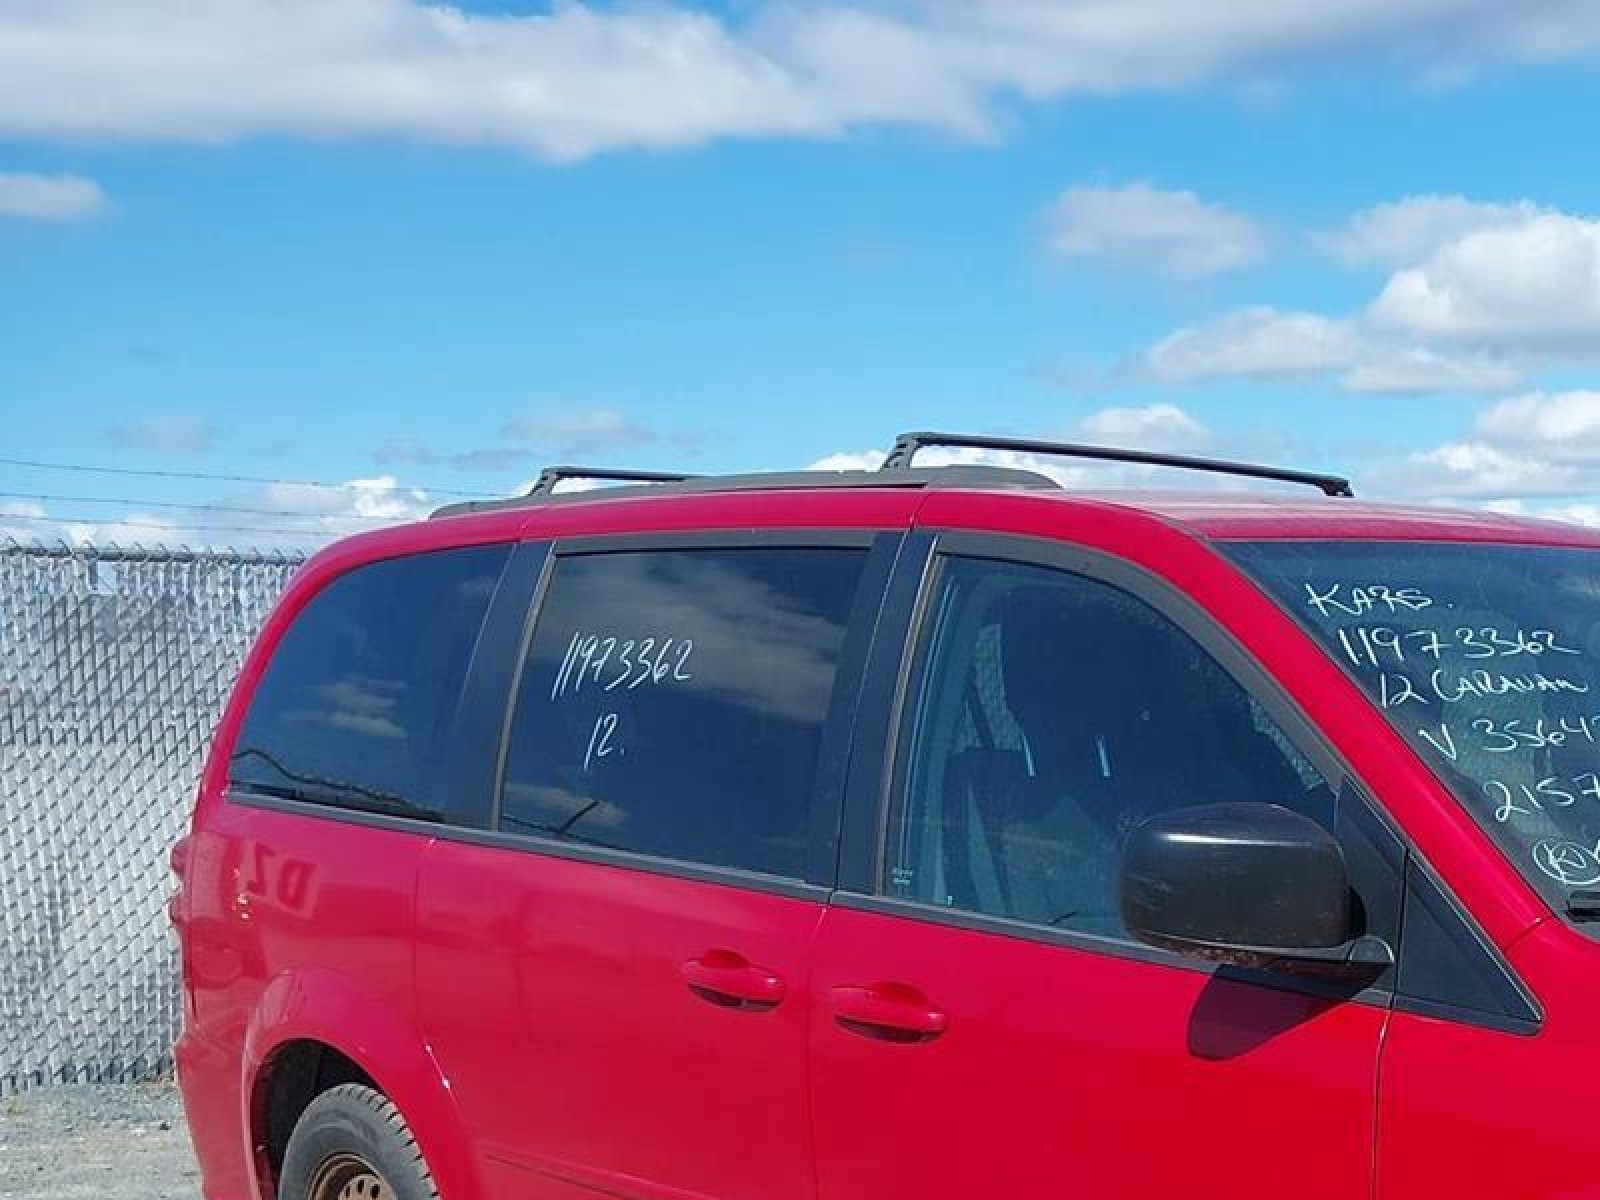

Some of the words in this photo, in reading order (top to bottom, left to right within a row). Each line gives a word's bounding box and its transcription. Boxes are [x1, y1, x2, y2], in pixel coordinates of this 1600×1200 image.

[551, 631, 694, 702] 11973362
[1380, 673, 1429, 708] 12
[1418, 722, 1457, 761] V
